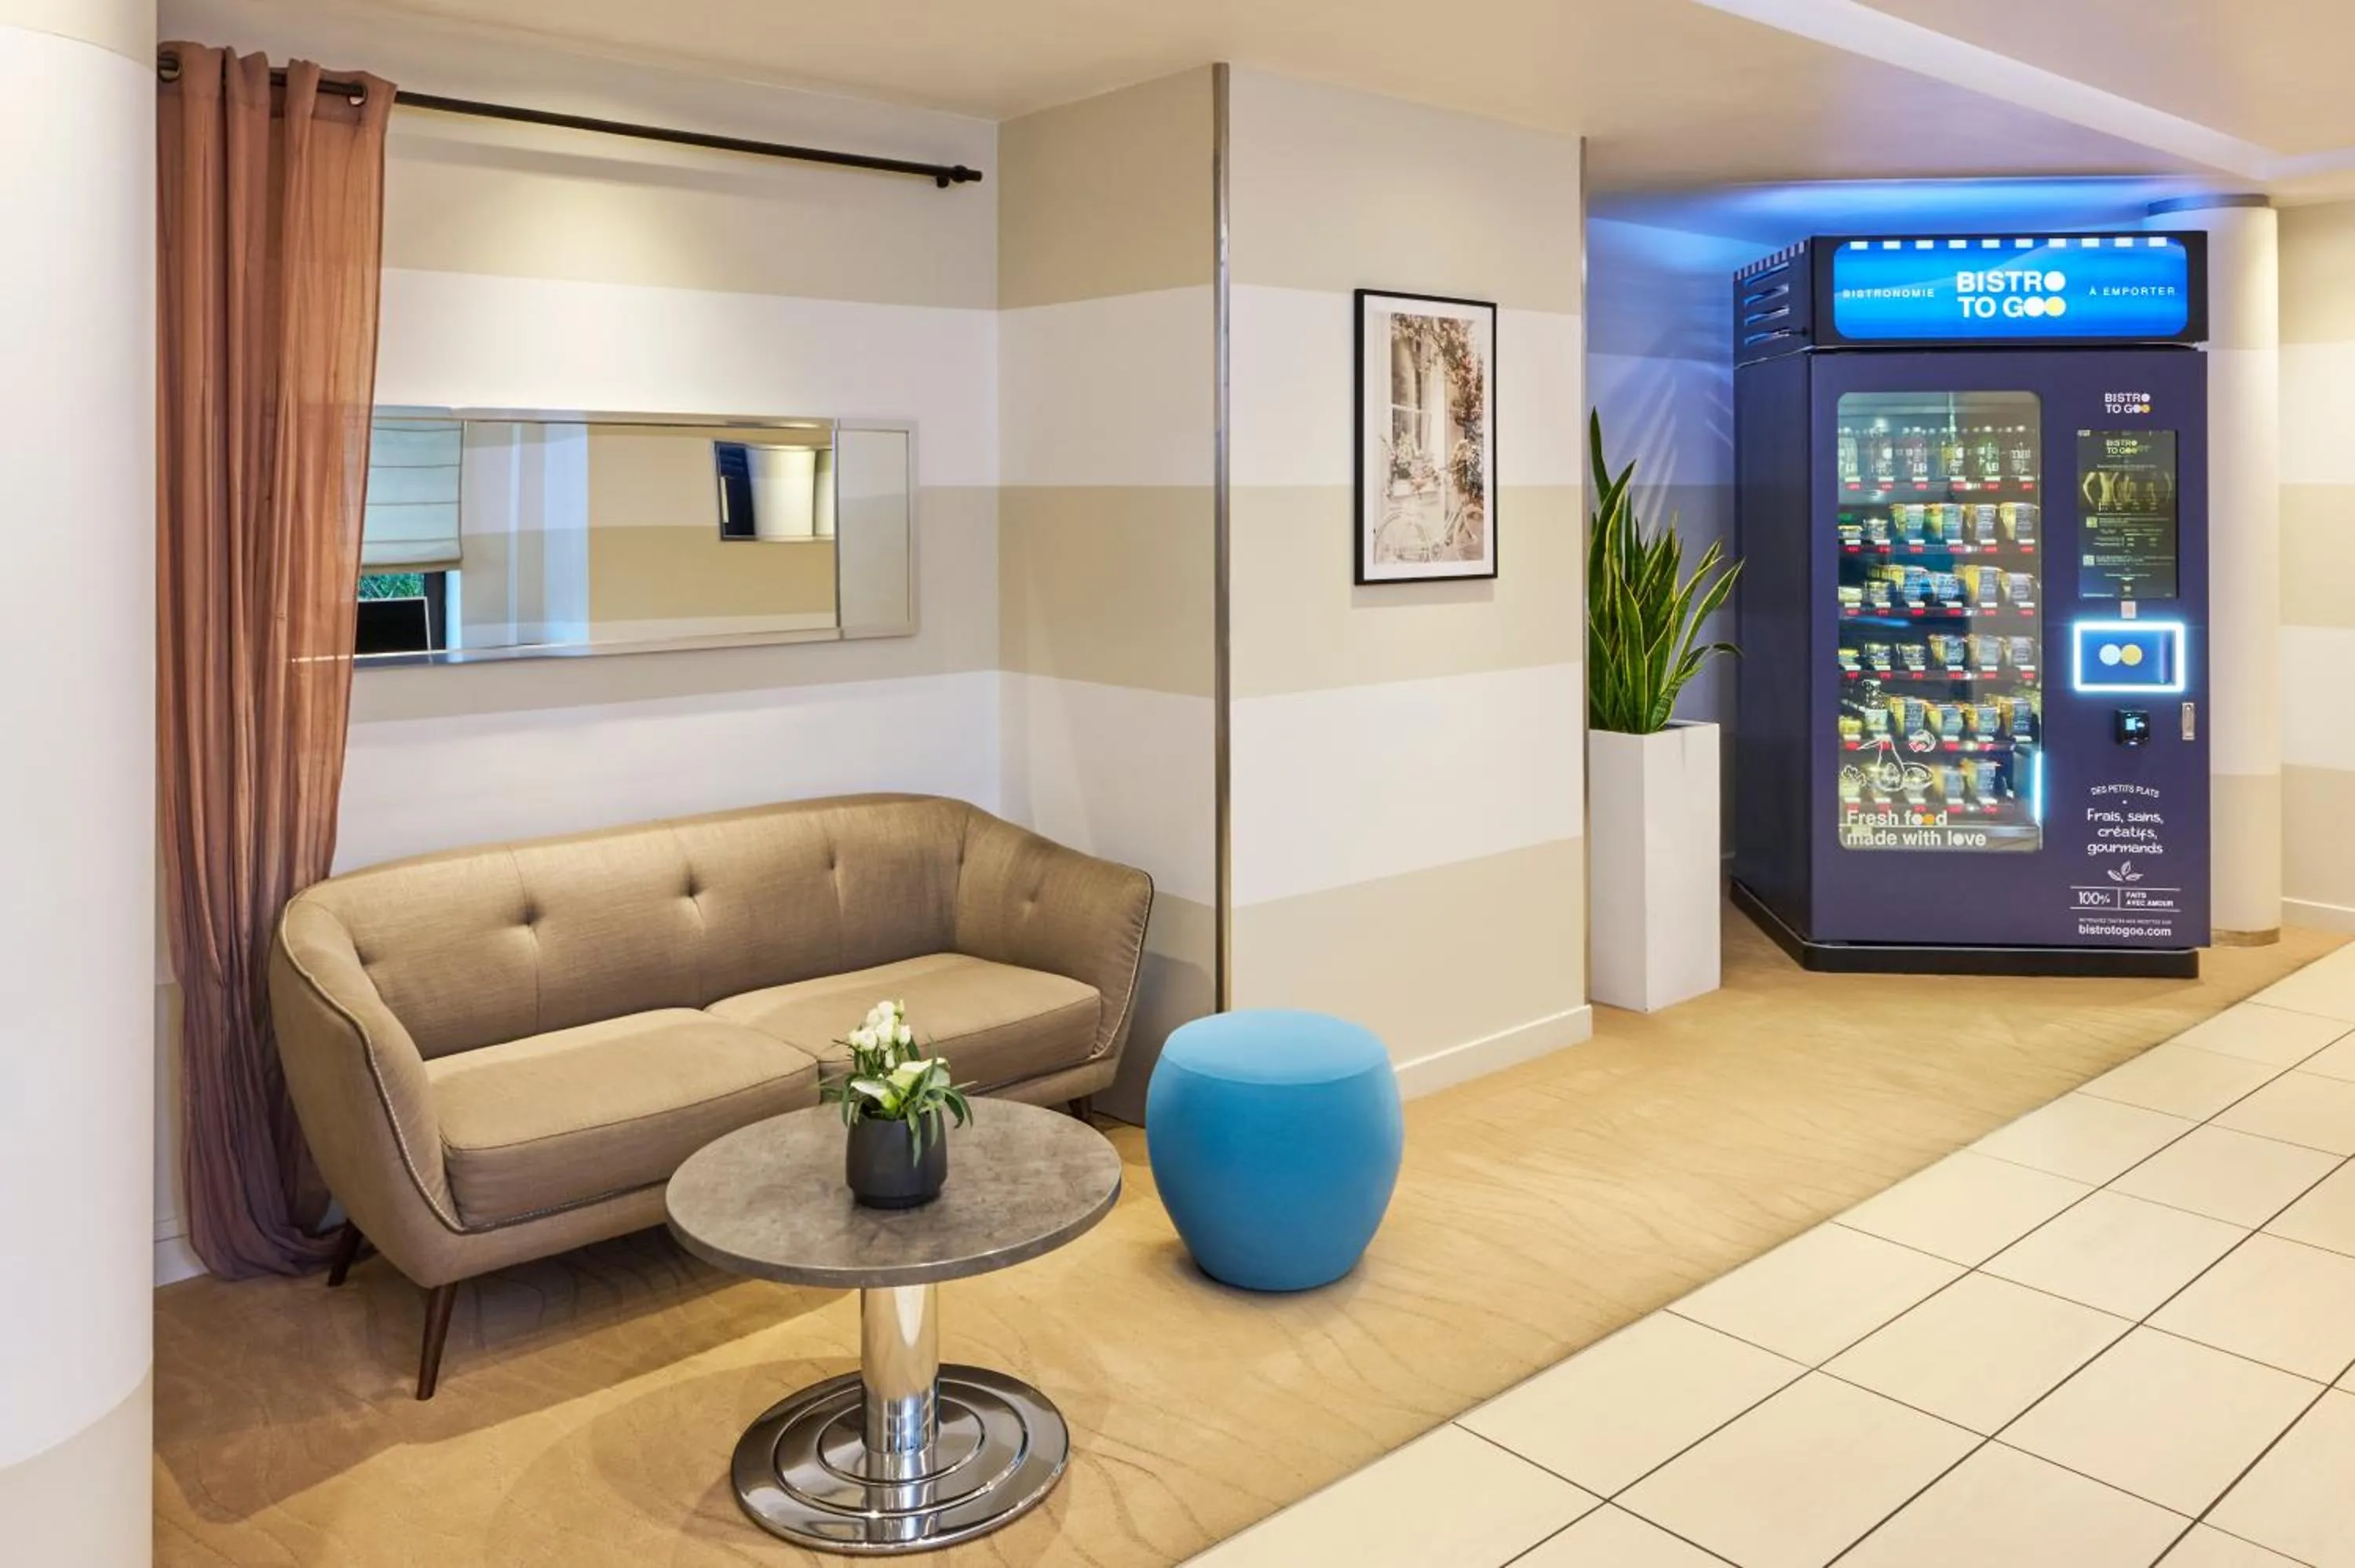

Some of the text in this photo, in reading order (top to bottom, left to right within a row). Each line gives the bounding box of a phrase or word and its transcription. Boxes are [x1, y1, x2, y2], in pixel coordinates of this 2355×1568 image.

[1956, 270, 2066, 293] BISTRO
[1842, 288, 1934, 298] BISTRONOMIE
[2103, 286, 2175, 296] EMPORTER
[1957, 296, 2067, 318] TO GOO
[2105, 392, 2150, 403] BISTRO
[2105, 403, 2150, 414] TO GOO
[2090, 784, 2160, 798] DES PETITS PLATS
[1847, 810, 1948, 826] Fresh food
[2087, 808, 2164, 825] Frais, sains,
[1847, 830, 1987, 846] made with love
[2097, 826, 2158, 841] créatifs,
[2087, 842, 2163, 856] gourmands
[2078, 891, 2111, 905] 100%
[2078, 924, 2172, 938] bistrotogoo.com
